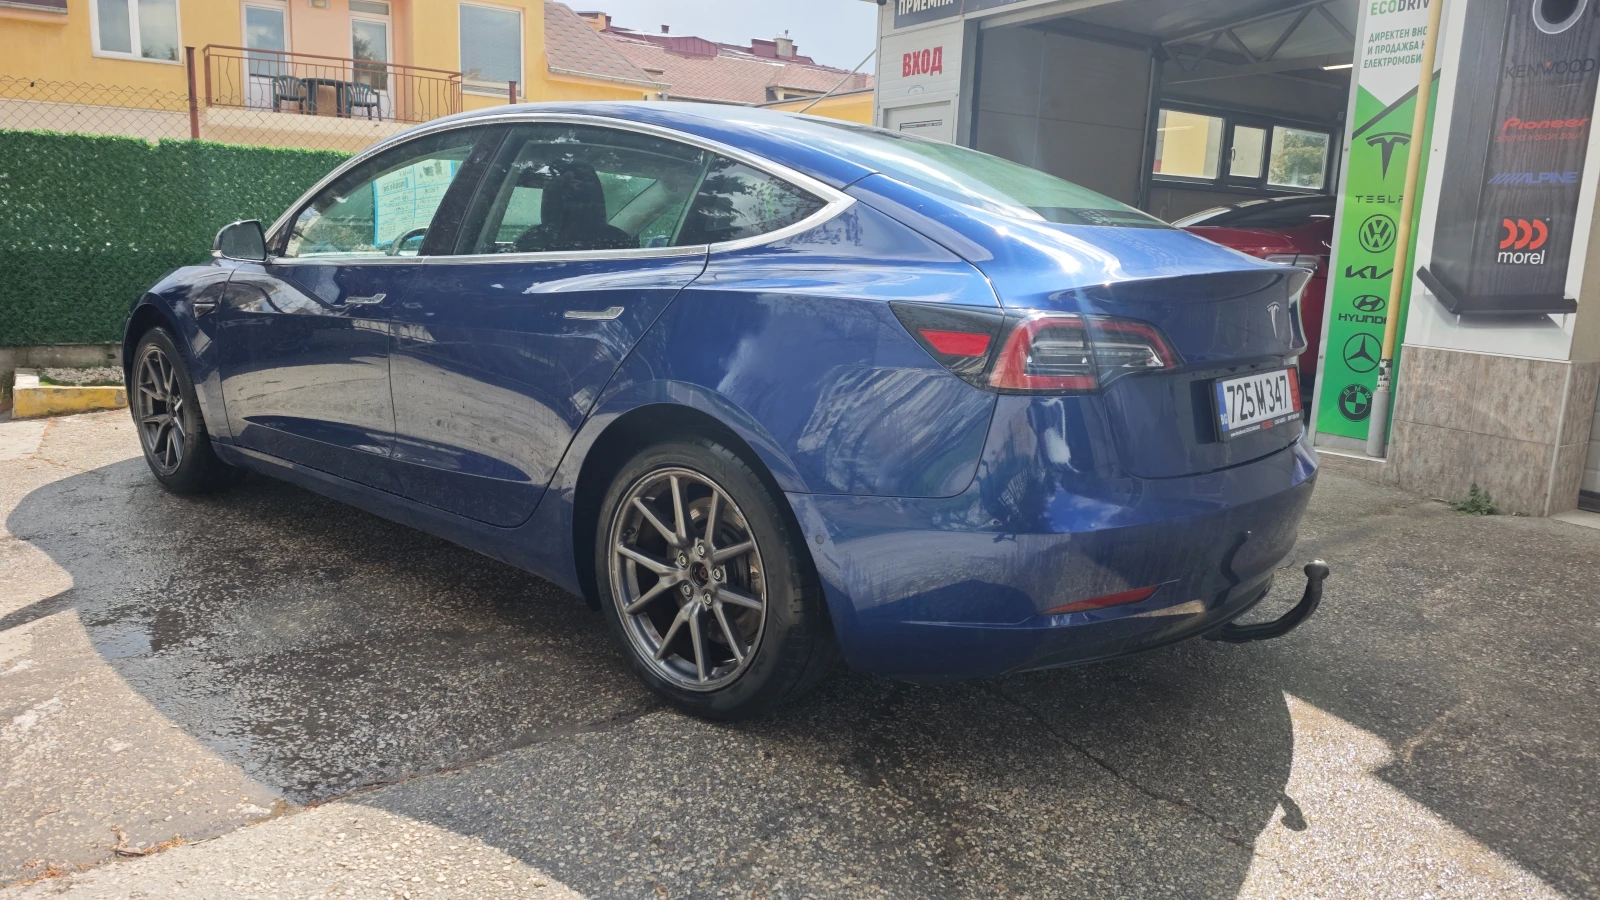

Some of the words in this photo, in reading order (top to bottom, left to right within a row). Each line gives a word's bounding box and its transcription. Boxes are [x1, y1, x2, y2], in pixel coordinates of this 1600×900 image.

[898, 0, 953, 16] ПРИЕМ
[1370, 0, 1430, 16] ECODRIV
[1368, 28, 1410, 43] ДИРЕКТЕН
[1412, 25, 1427, 37] ВНО
[1367, 45, 1373, 55] И
[1374, 41, 1419, 54] ПРОДАЖБА
[902, 46, 942, 77] ВХОД
[1363, 53, 1424, 69] ЕЛЕКТРОМОБИ
[1505, 58, 1595, 79] KENWOOD
[1502, 117, 1589, 131] Pioneer
[1510, 171, 1578, 184] ALPINE
[1497, 249, 1546, 265] morel
[1338, 312, 1387, 325] HYUND
